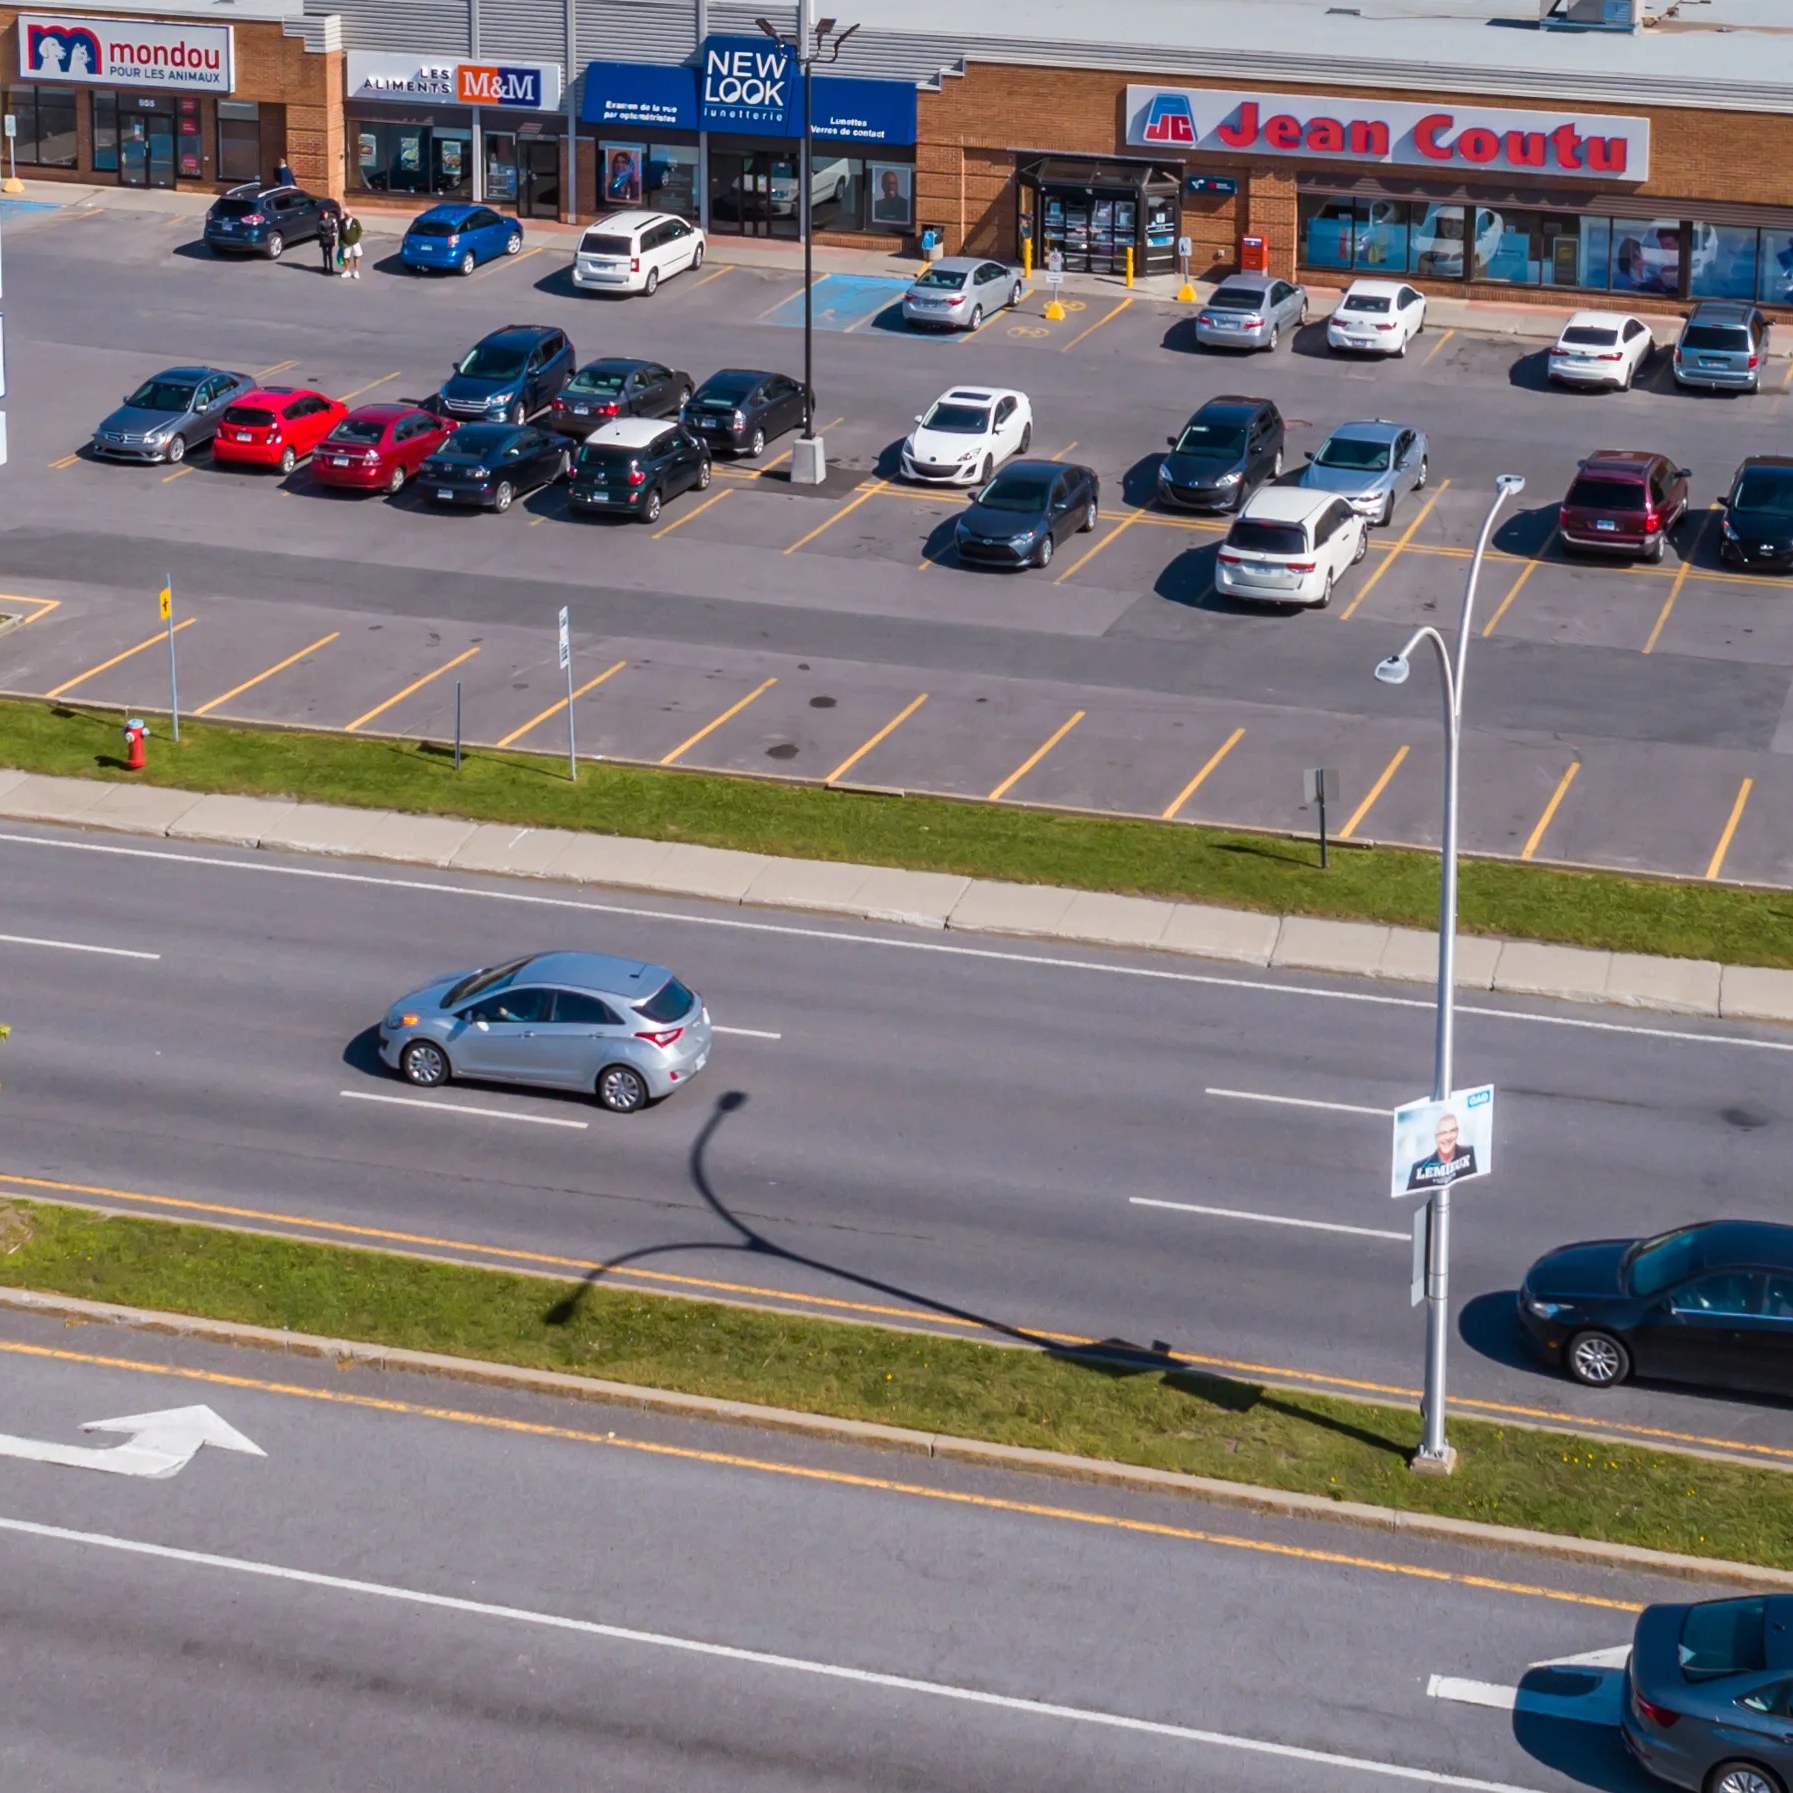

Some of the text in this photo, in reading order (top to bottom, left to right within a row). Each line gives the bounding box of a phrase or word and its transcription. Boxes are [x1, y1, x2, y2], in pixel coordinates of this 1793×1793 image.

[109, 41, 220, 70] mondou
[707, 50, 788, 80] NEW
[110, 66, 220, 84] POUR LES ANIMAUX
[420, 67, 450, 80] LES
[364, 78, 451, 95] ALIMENTS
[463, 70, 534, 101] M&M
[705, 76, 786, 107] LOOK
[703, 107, 784, 122] lunetterie
[830, 116, 868, 127] Lunettes
[840, 127, 851, 136] de
[852, 128, 885, 139] contact
[1217, 101, 1628, 173] Jean Coutu
[1416, 1154, 1471, 1180] LEMIEUX
